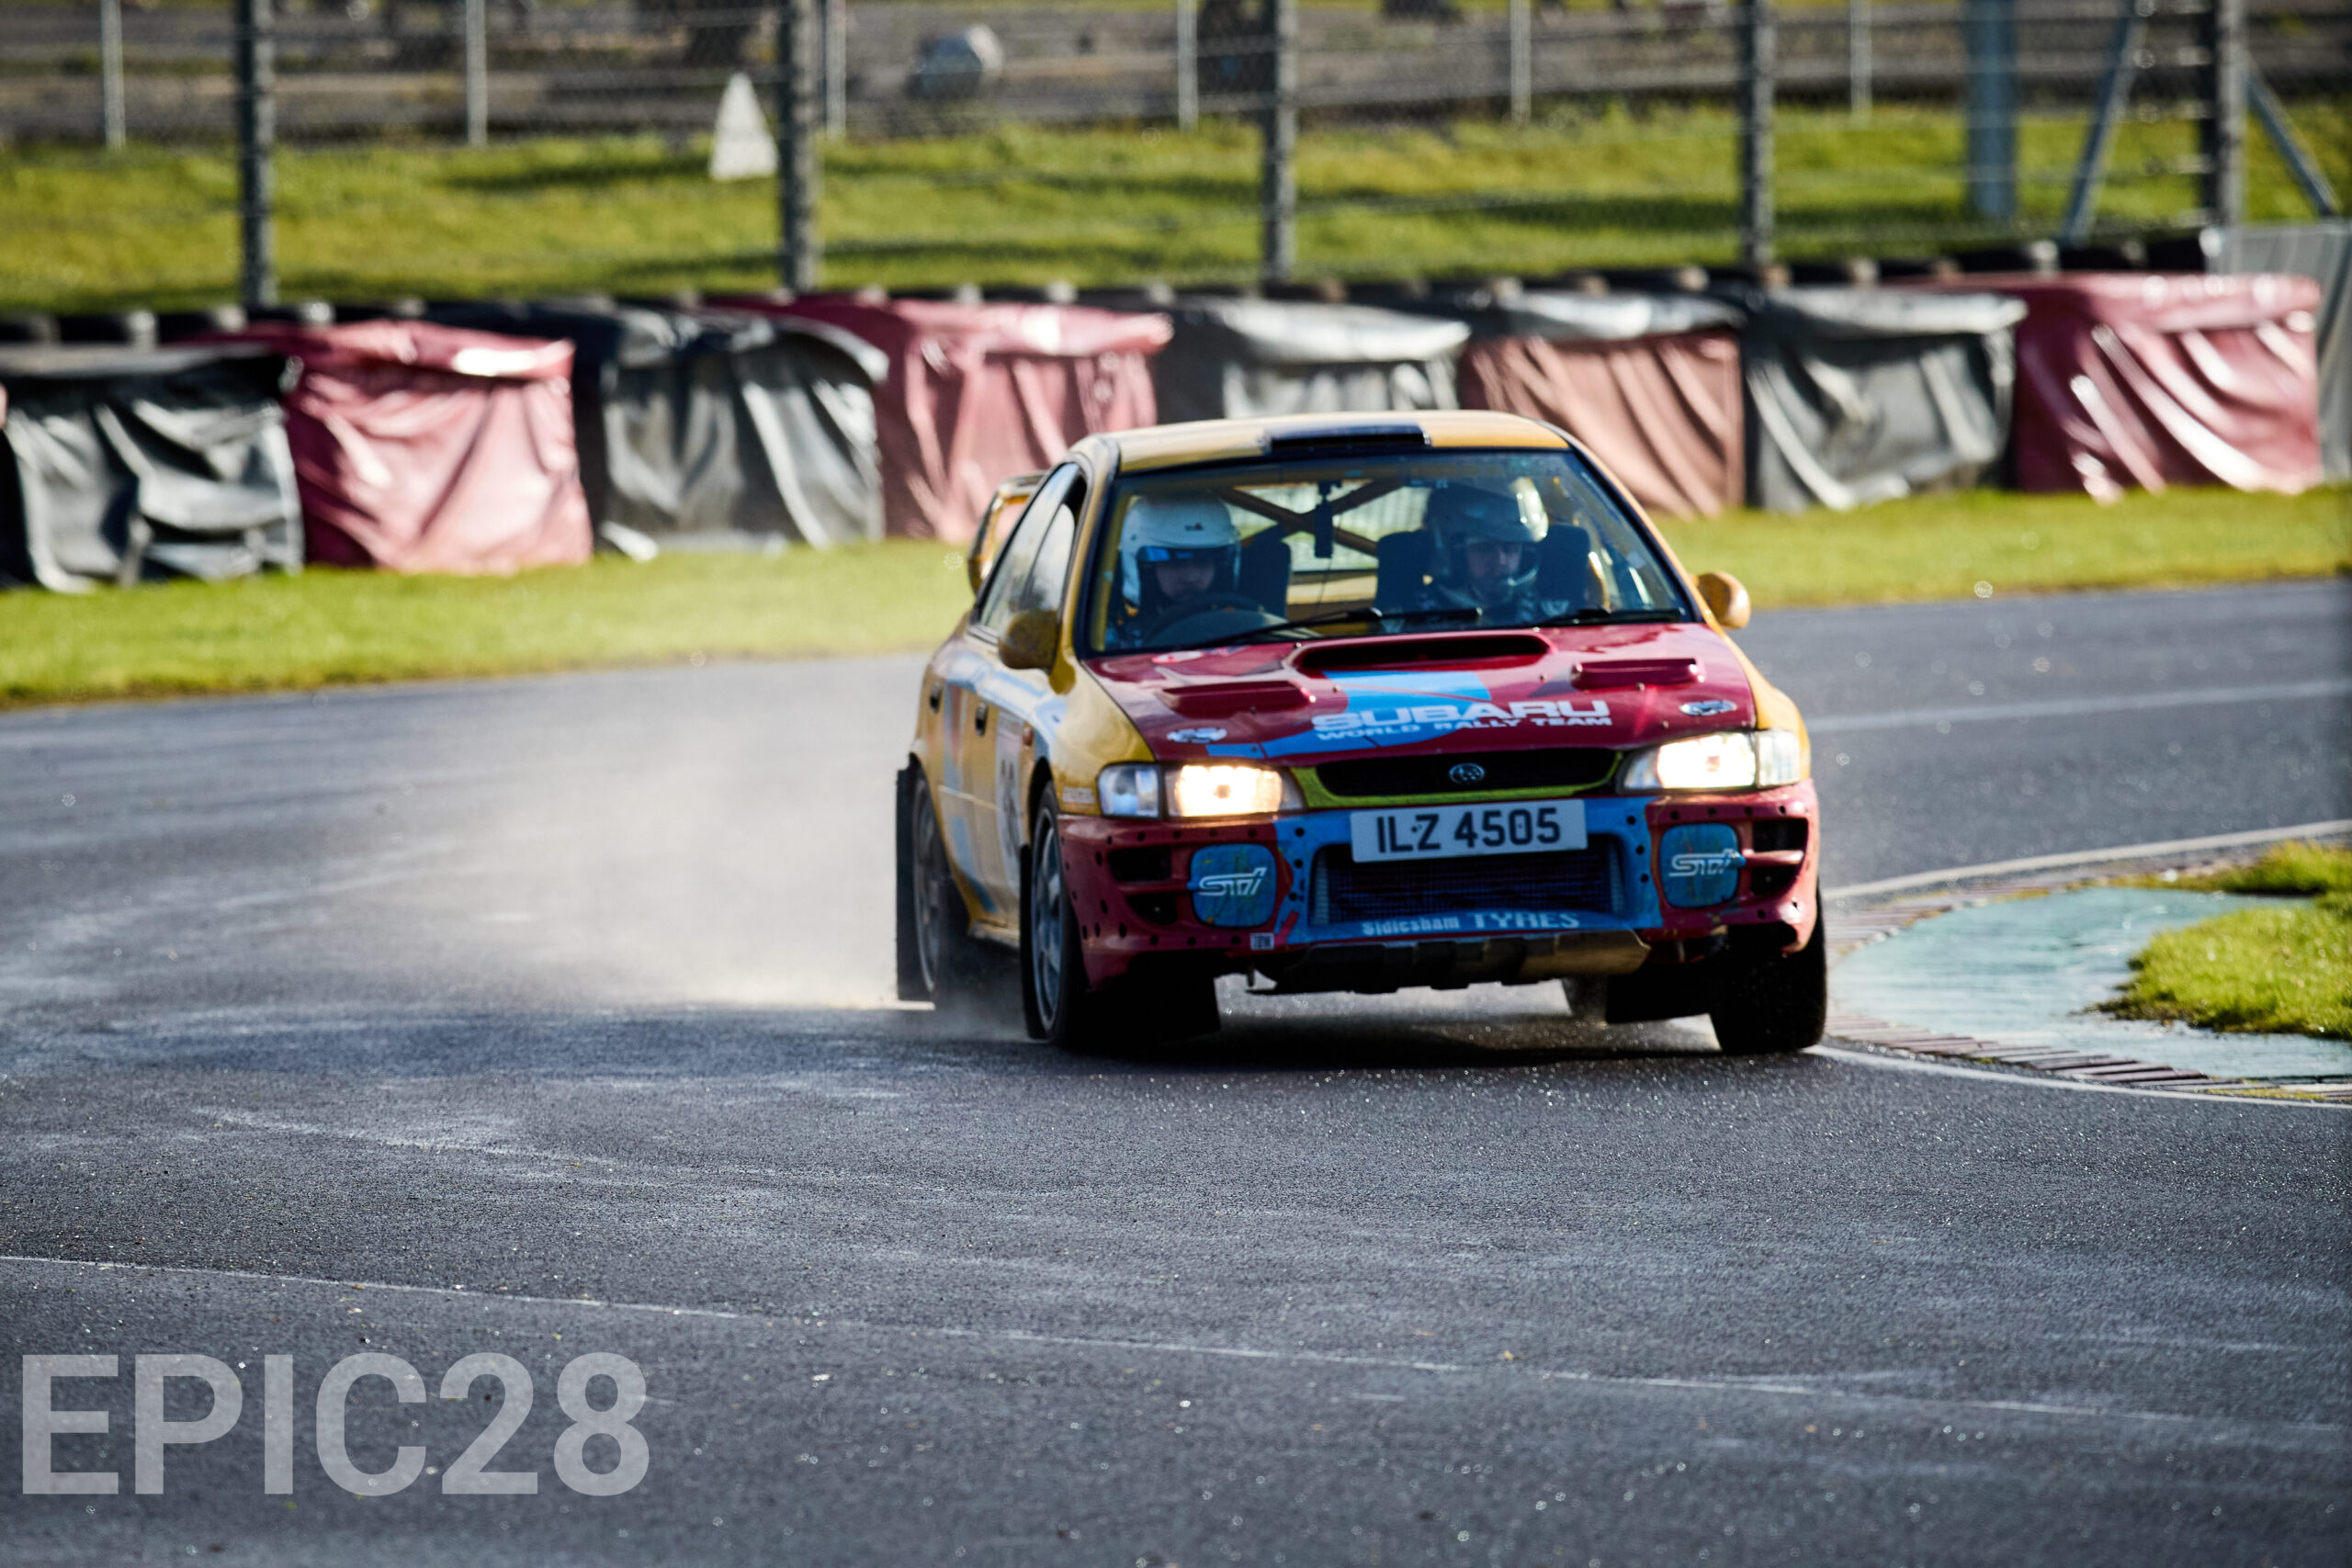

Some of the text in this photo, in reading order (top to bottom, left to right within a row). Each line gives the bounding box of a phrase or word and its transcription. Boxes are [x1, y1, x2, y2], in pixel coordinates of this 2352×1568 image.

[1311, 700, 1611, 731] SUBARU
[1316, 716, 1612, 740] WORLD RALLY TEAM
[1376, 807, 1561, 853] ILZ 4505
[1468, 911, 1580, 930] TYRES
